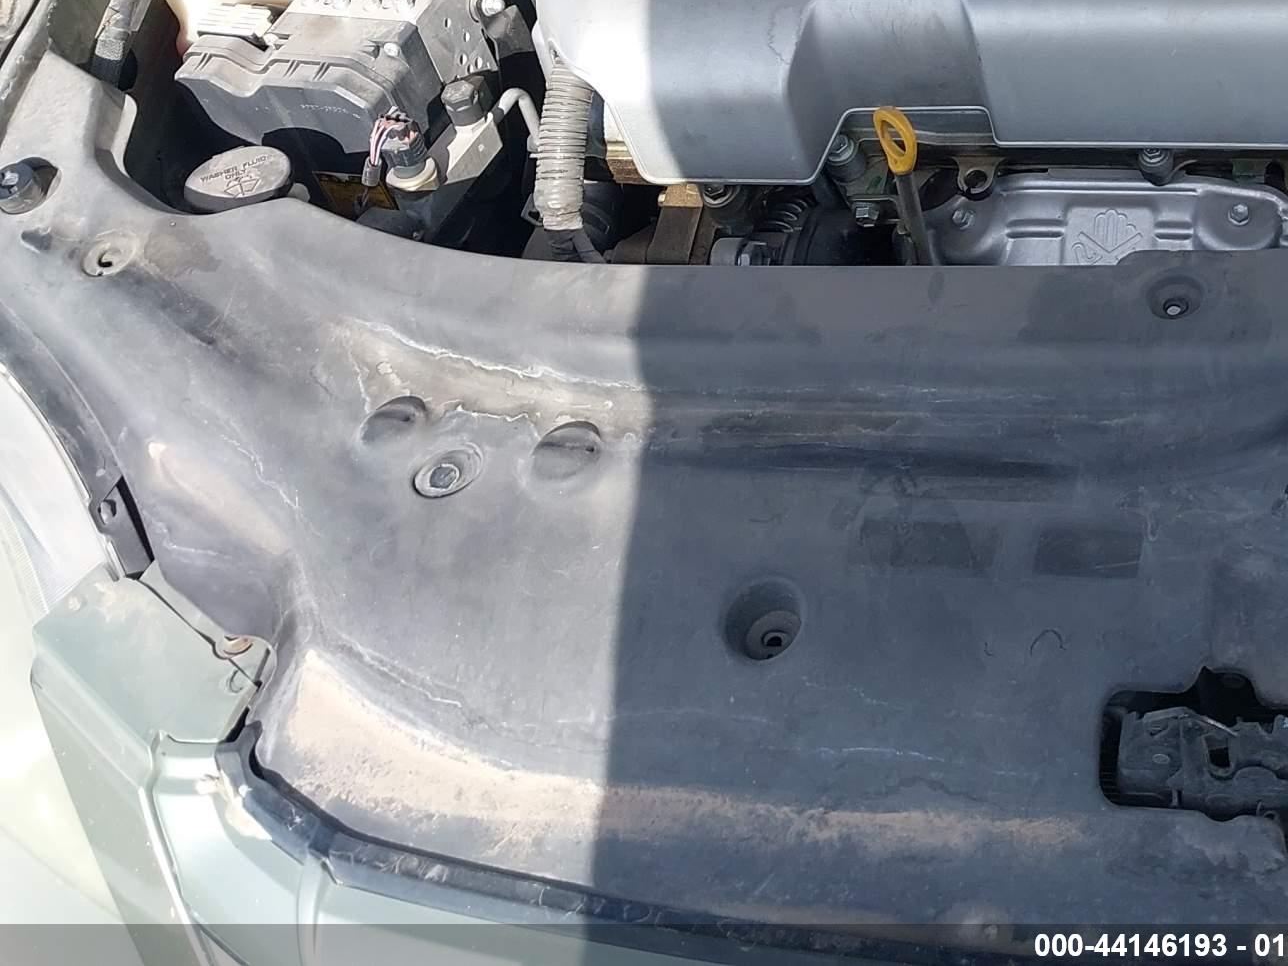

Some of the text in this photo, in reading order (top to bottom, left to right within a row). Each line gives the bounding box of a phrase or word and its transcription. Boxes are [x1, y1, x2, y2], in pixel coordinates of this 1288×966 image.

[199, 155, 268, 183] WASHER FLUID
[225, 168, 246, 180] ONLY
